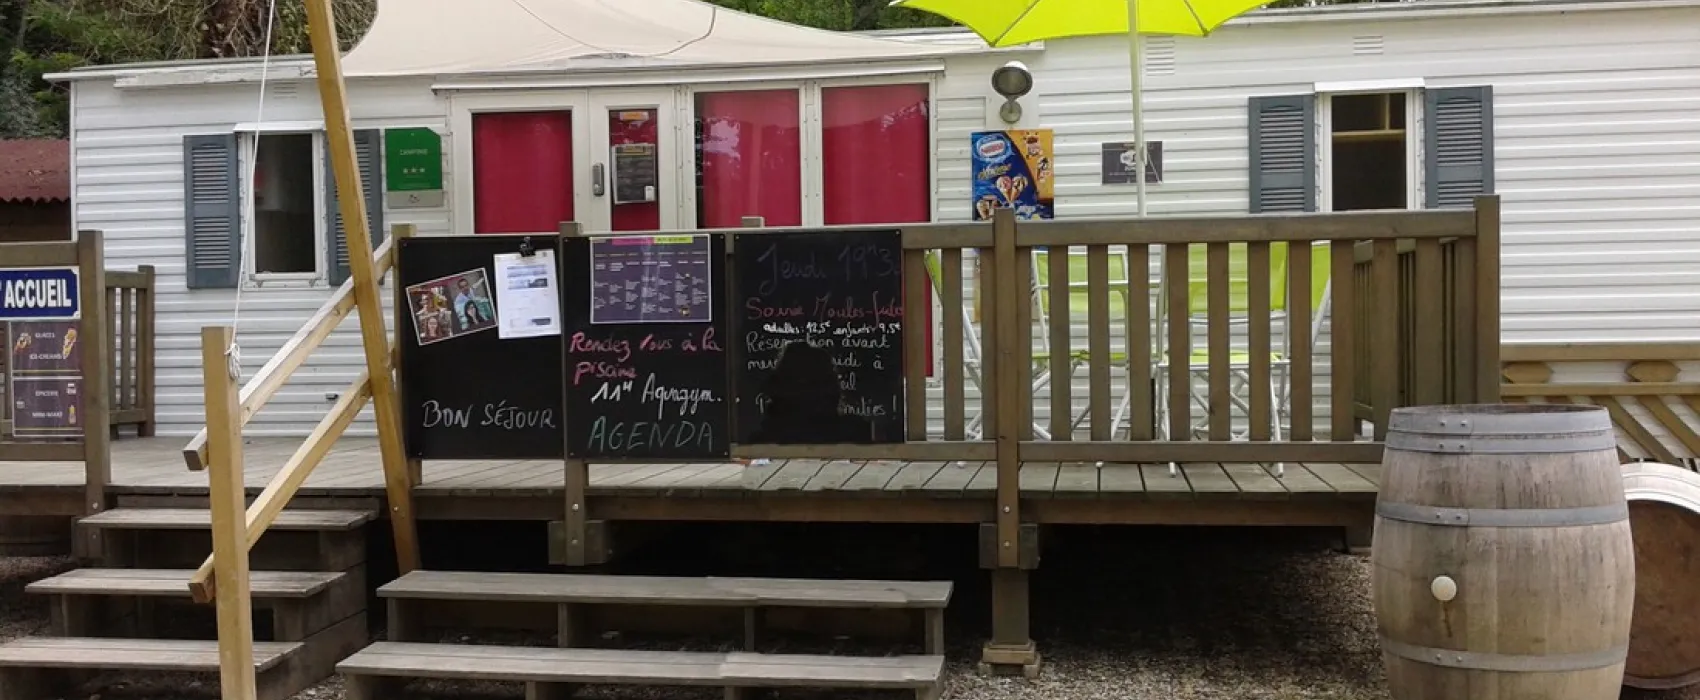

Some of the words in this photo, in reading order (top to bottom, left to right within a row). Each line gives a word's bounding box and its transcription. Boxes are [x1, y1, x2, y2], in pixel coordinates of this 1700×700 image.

[757, 243, 828, 296] Jeudi
[569, 331, 632, 362] Rendez
[702, 326, 724, 352] la
[841, 333, 891, 350] avant
[421, 399, 473, 429] BON
[480, 399, 557, 430] SÉJOUR
[587, 416, 714, 454] AGENDA
